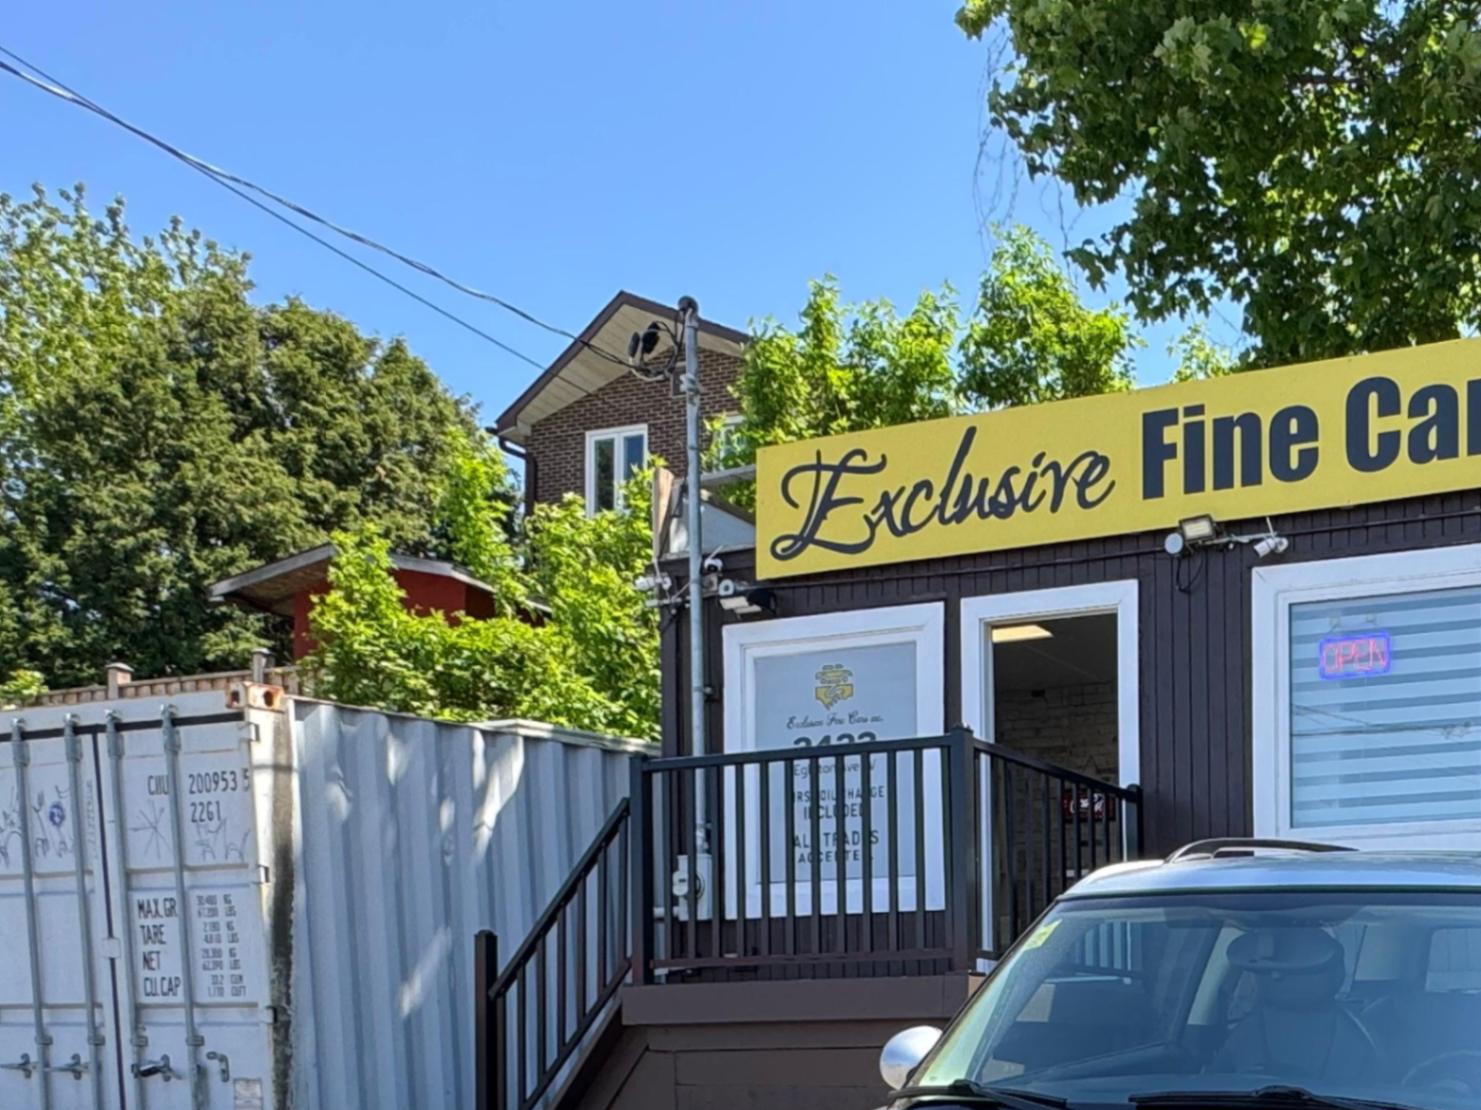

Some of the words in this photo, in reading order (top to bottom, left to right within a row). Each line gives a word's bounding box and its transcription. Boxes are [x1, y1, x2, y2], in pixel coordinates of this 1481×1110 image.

[770, 425, 1114, 561] Exclusive
[1141, 403, 1319, 500] Fine
[1324, 638, 1387, 674] OPEN
[188, 770, 238, 794] 200953
[139, 924, 166, 945] TARE
[143, 951, 160, 971] NET
